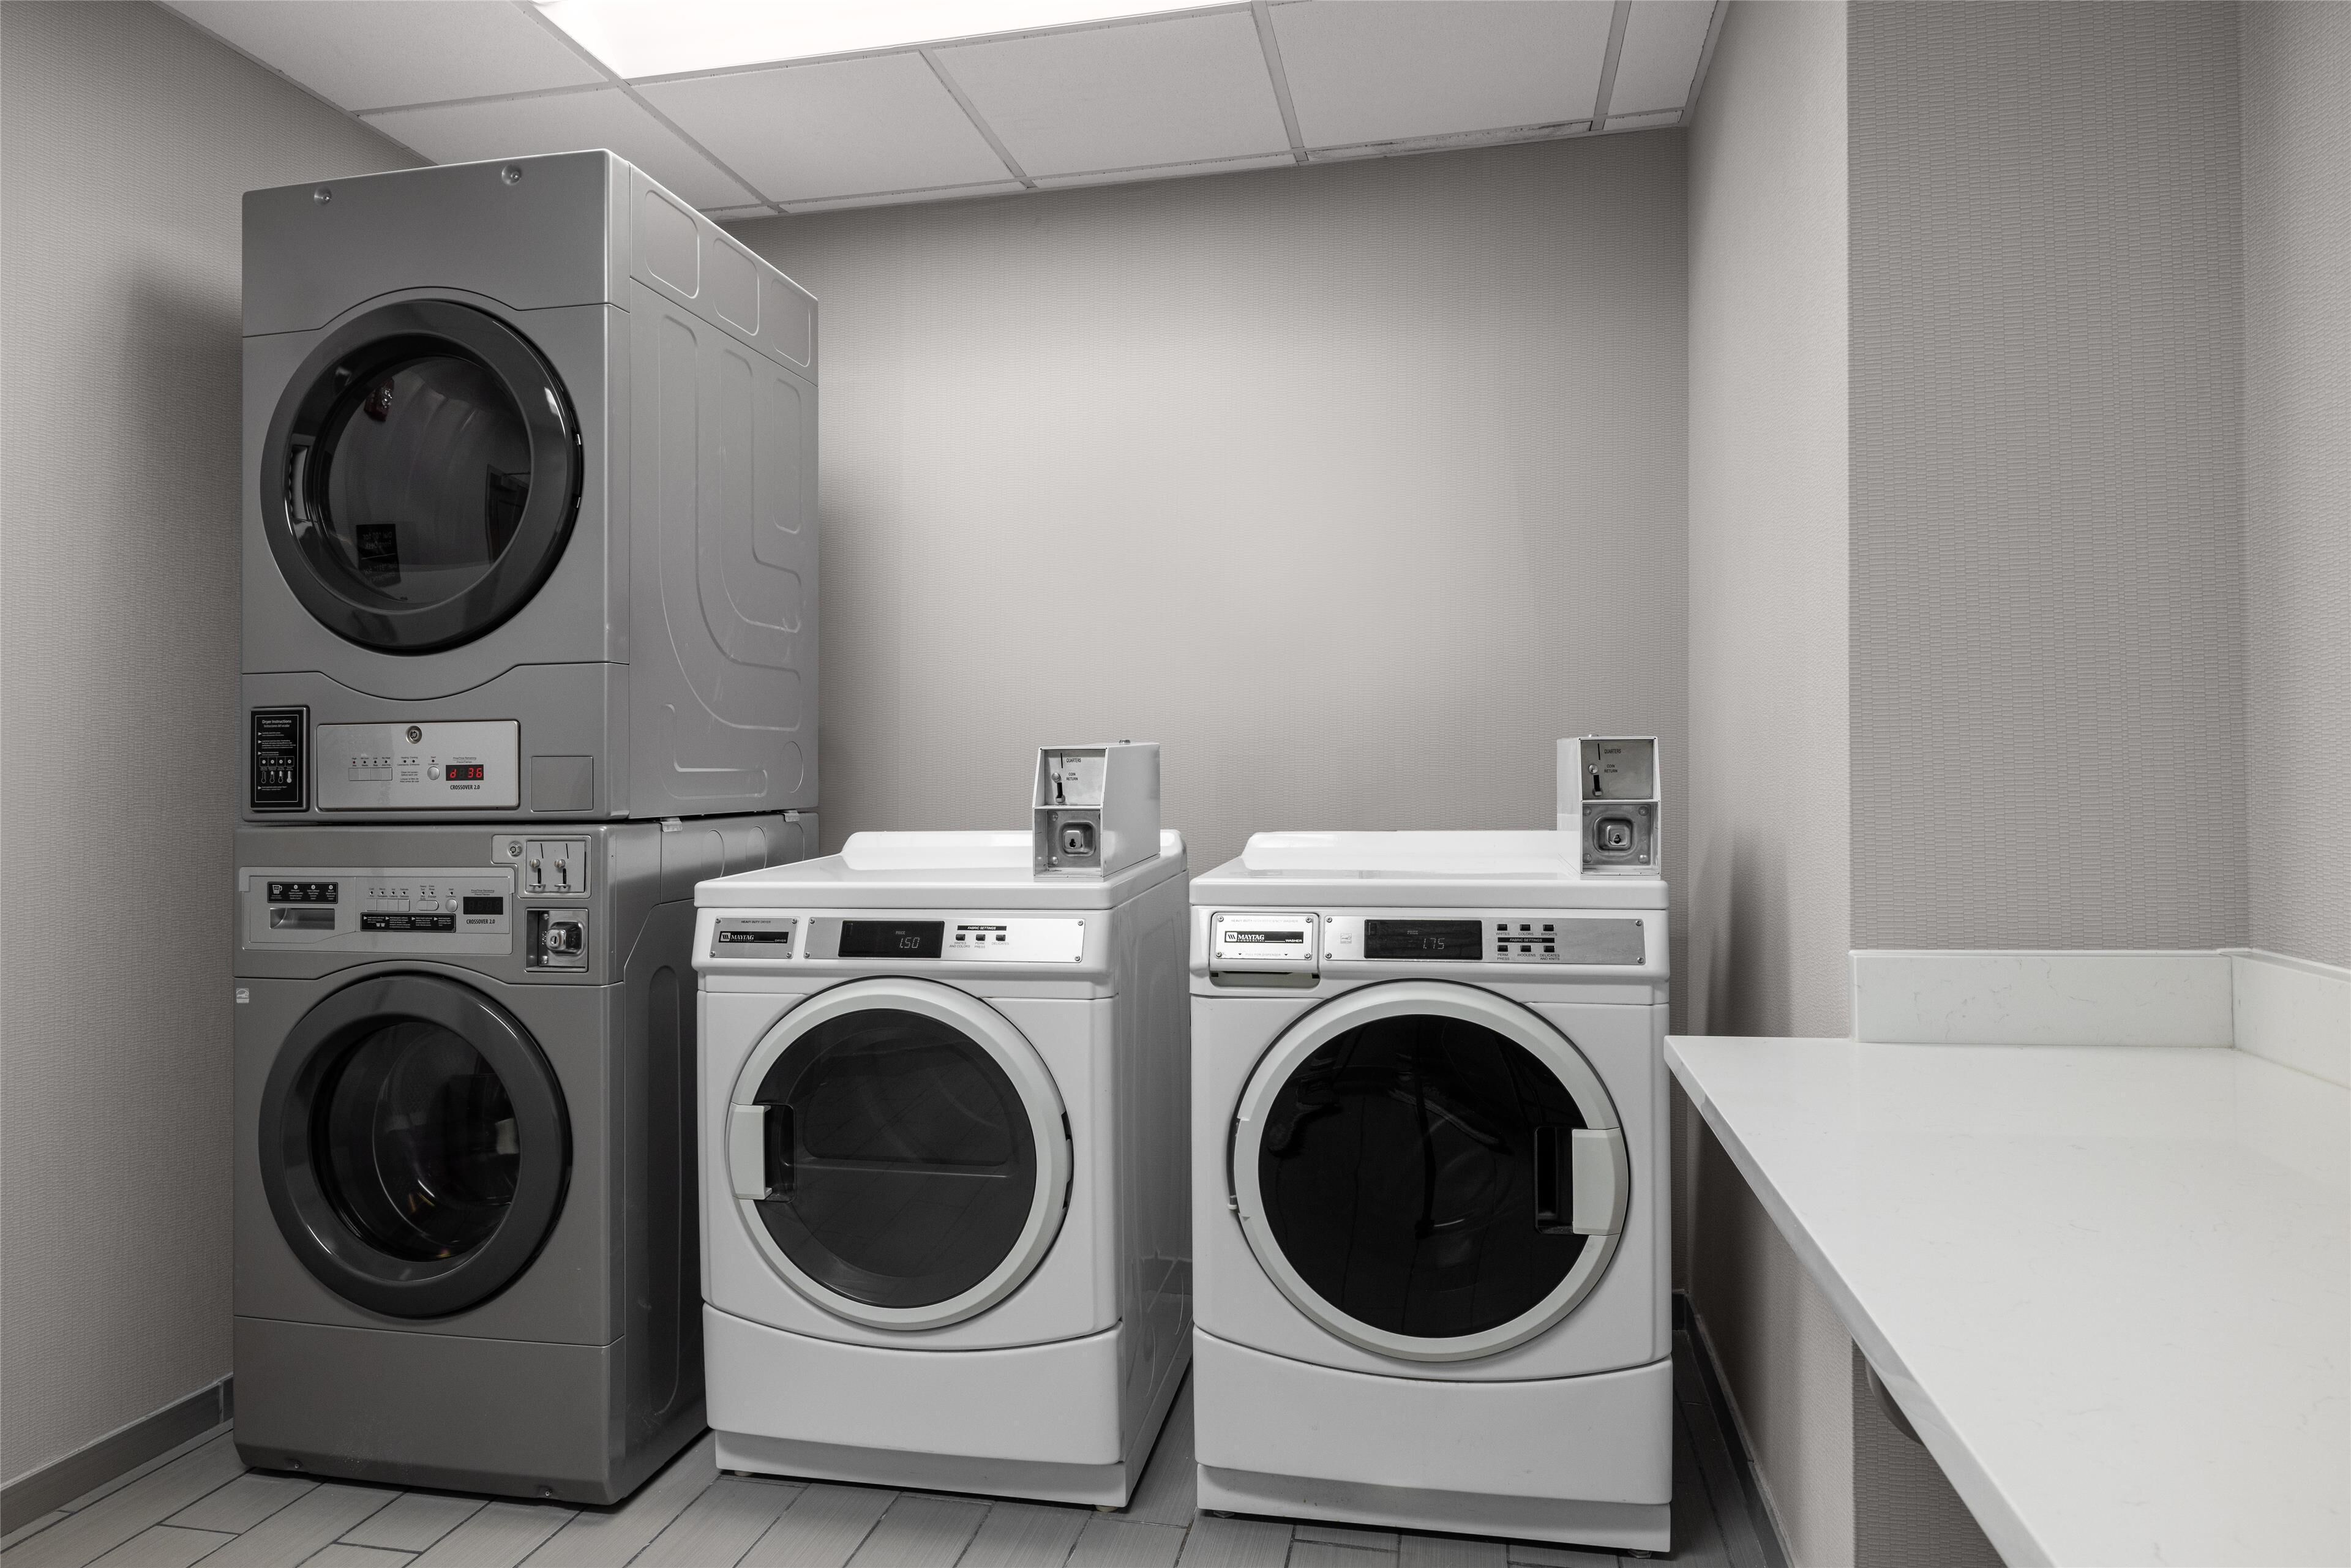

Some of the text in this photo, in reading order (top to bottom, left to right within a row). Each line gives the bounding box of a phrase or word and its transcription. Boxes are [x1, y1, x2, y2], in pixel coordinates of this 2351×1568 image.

[468, 768, 482, 778] 36
[899, 937, 920, 948] 1.50
[1423, 938, 1445, 950] 1.75
